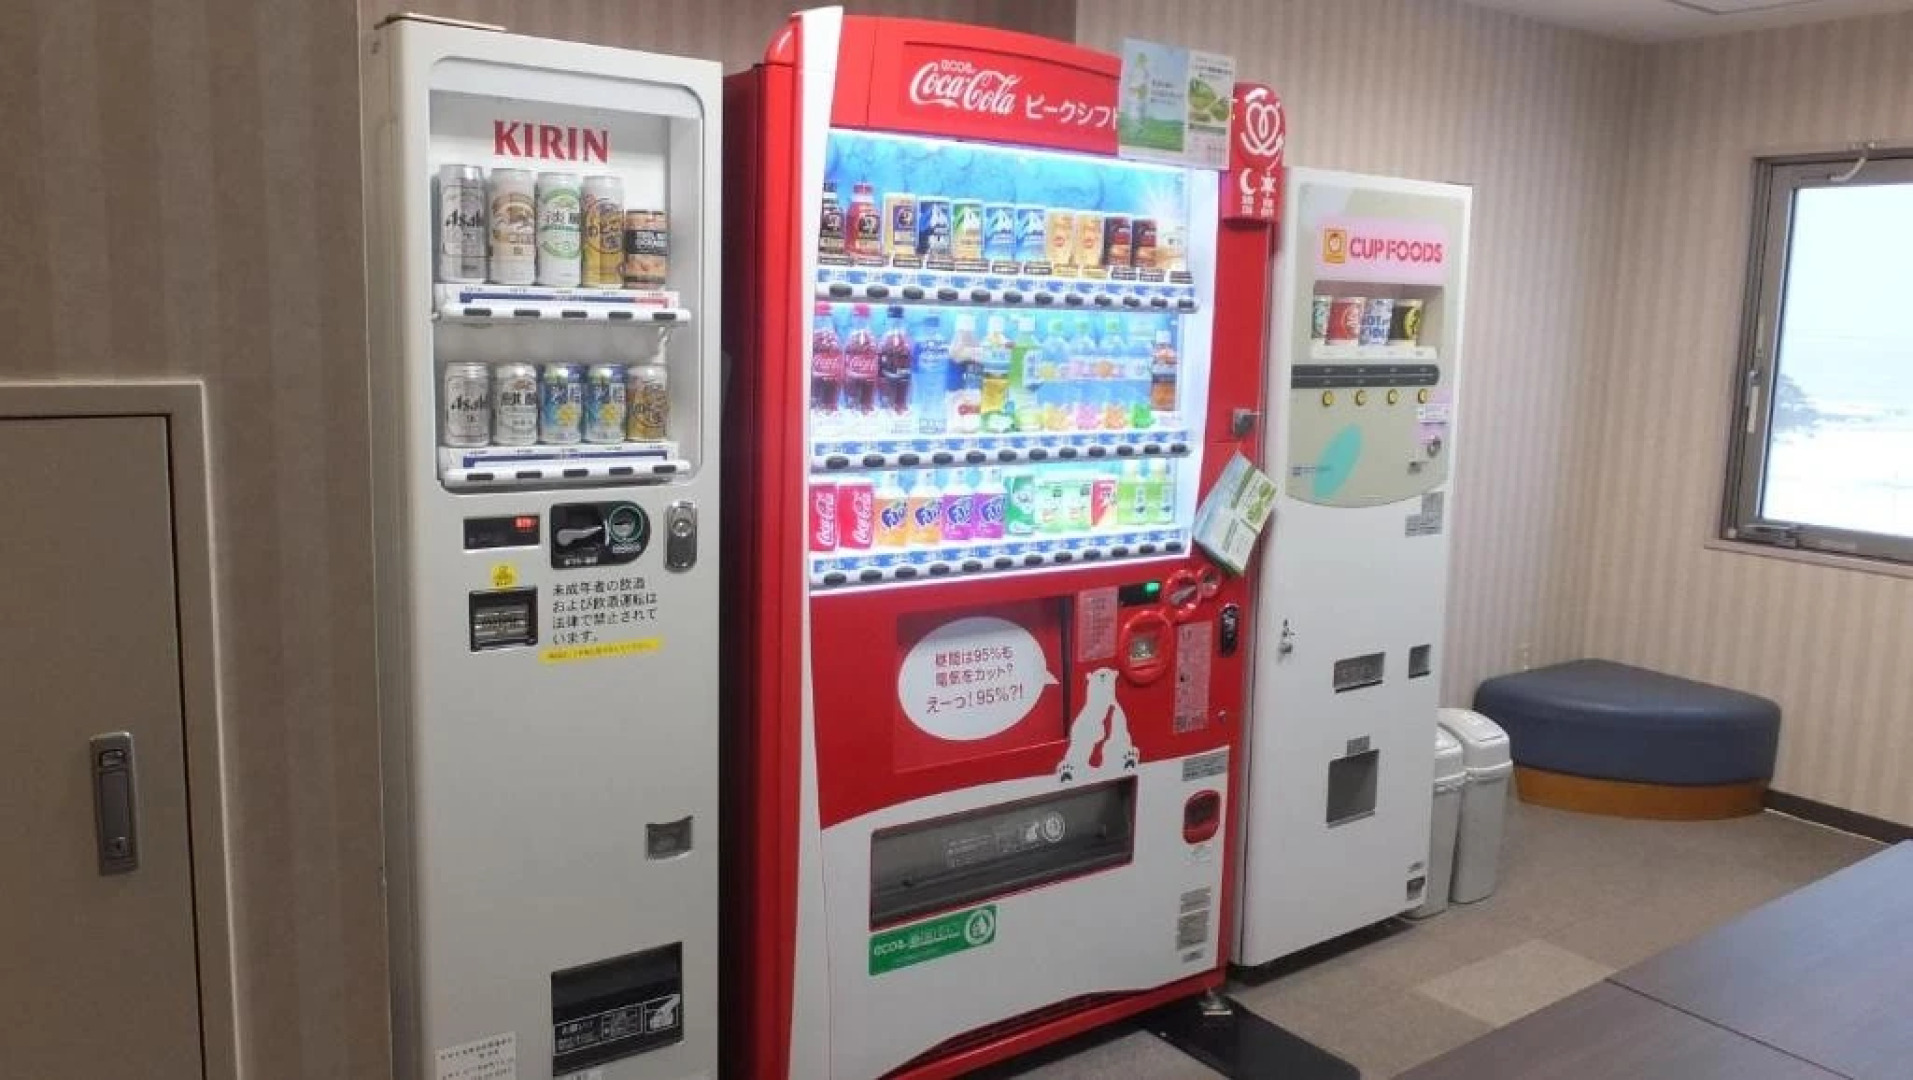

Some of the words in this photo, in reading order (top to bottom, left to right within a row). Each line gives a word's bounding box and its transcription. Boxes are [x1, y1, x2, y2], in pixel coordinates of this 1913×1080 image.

[909, 61, 1023, 114] Coca-Cola
[493, 119, 610, 164] KIRIN
[1350, 237, 1385, 259] CUP
[1386, 240, 1443, 263] FOODS
[553, 608, 658, 629] 法律で禁止されて
[553, 631, 599, 645] います。
